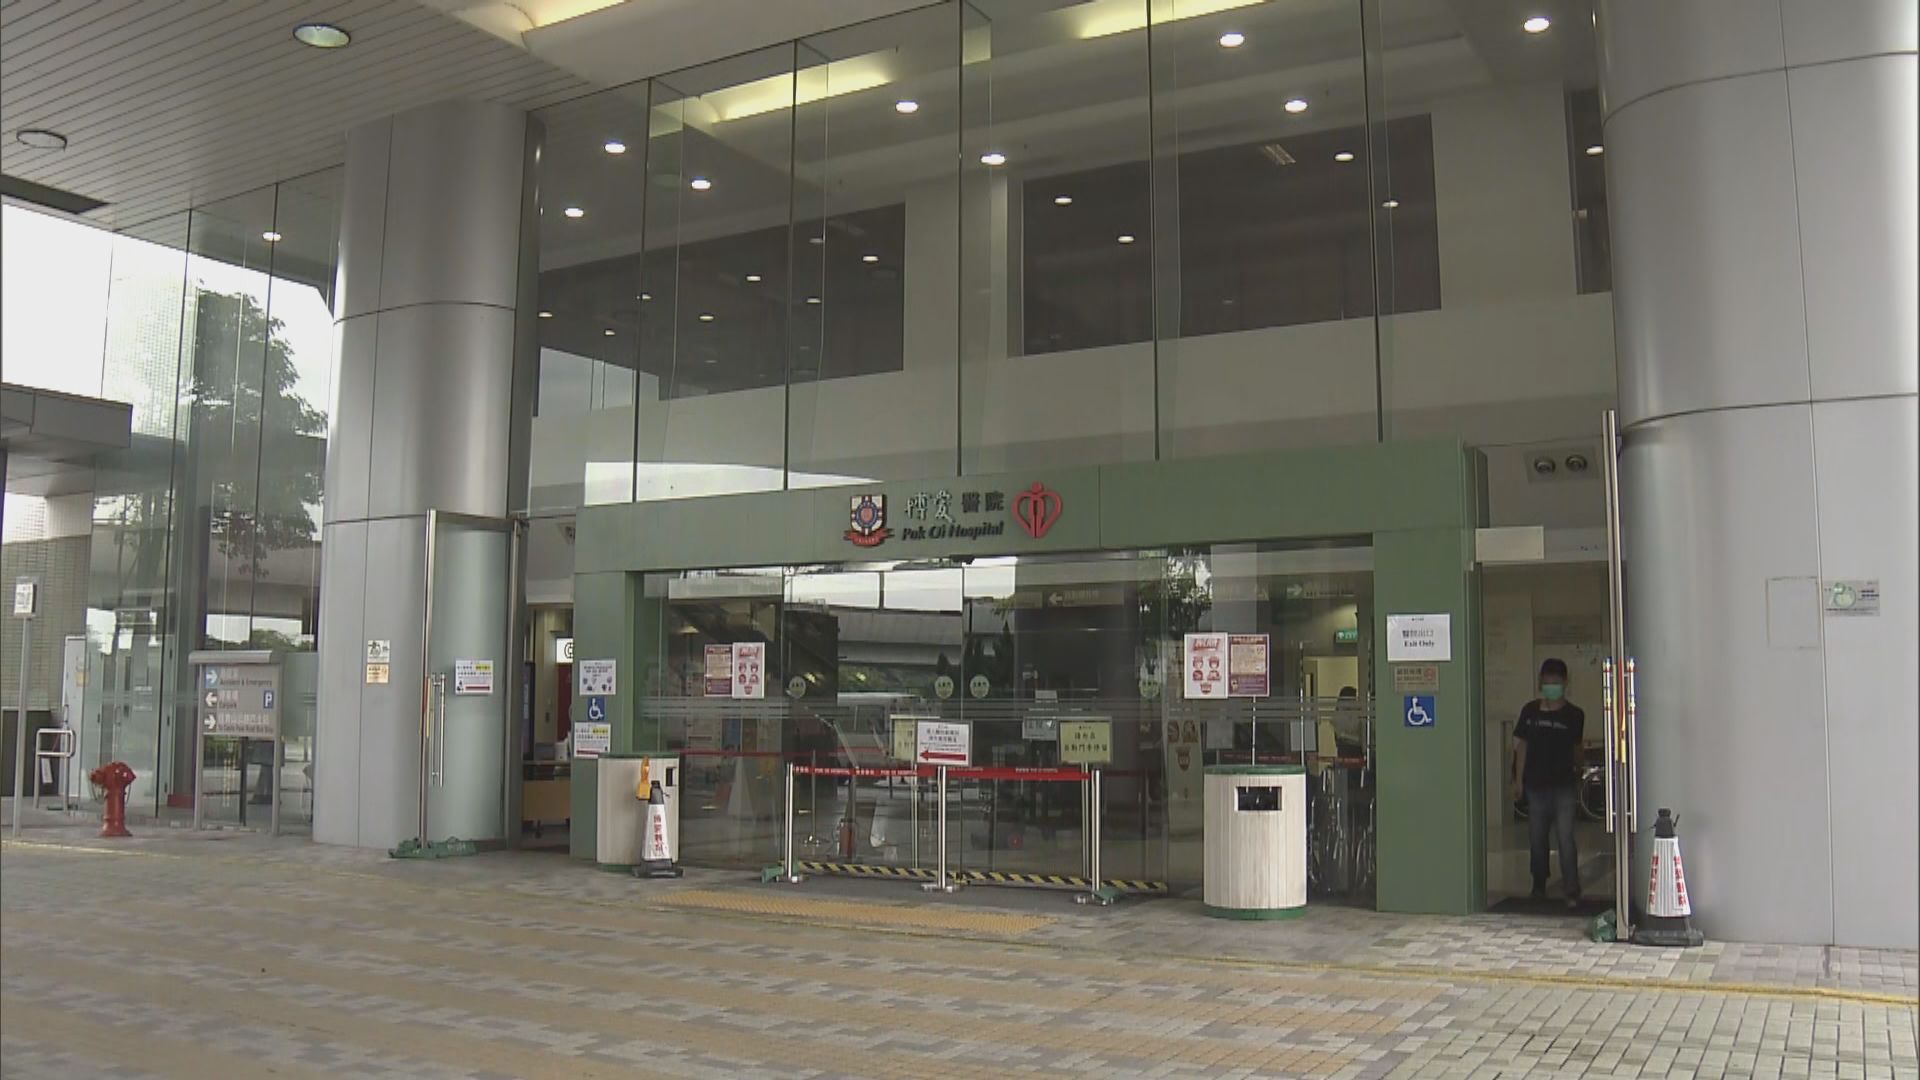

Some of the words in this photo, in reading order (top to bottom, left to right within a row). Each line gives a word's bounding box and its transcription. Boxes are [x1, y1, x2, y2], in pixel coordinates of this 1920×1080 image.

[902, 528, 926, 541] Pok
[928, 526, 946, 539] Oi
[949, 521, 1004, 541] Hospital
[265, 692, 272, 707] P
